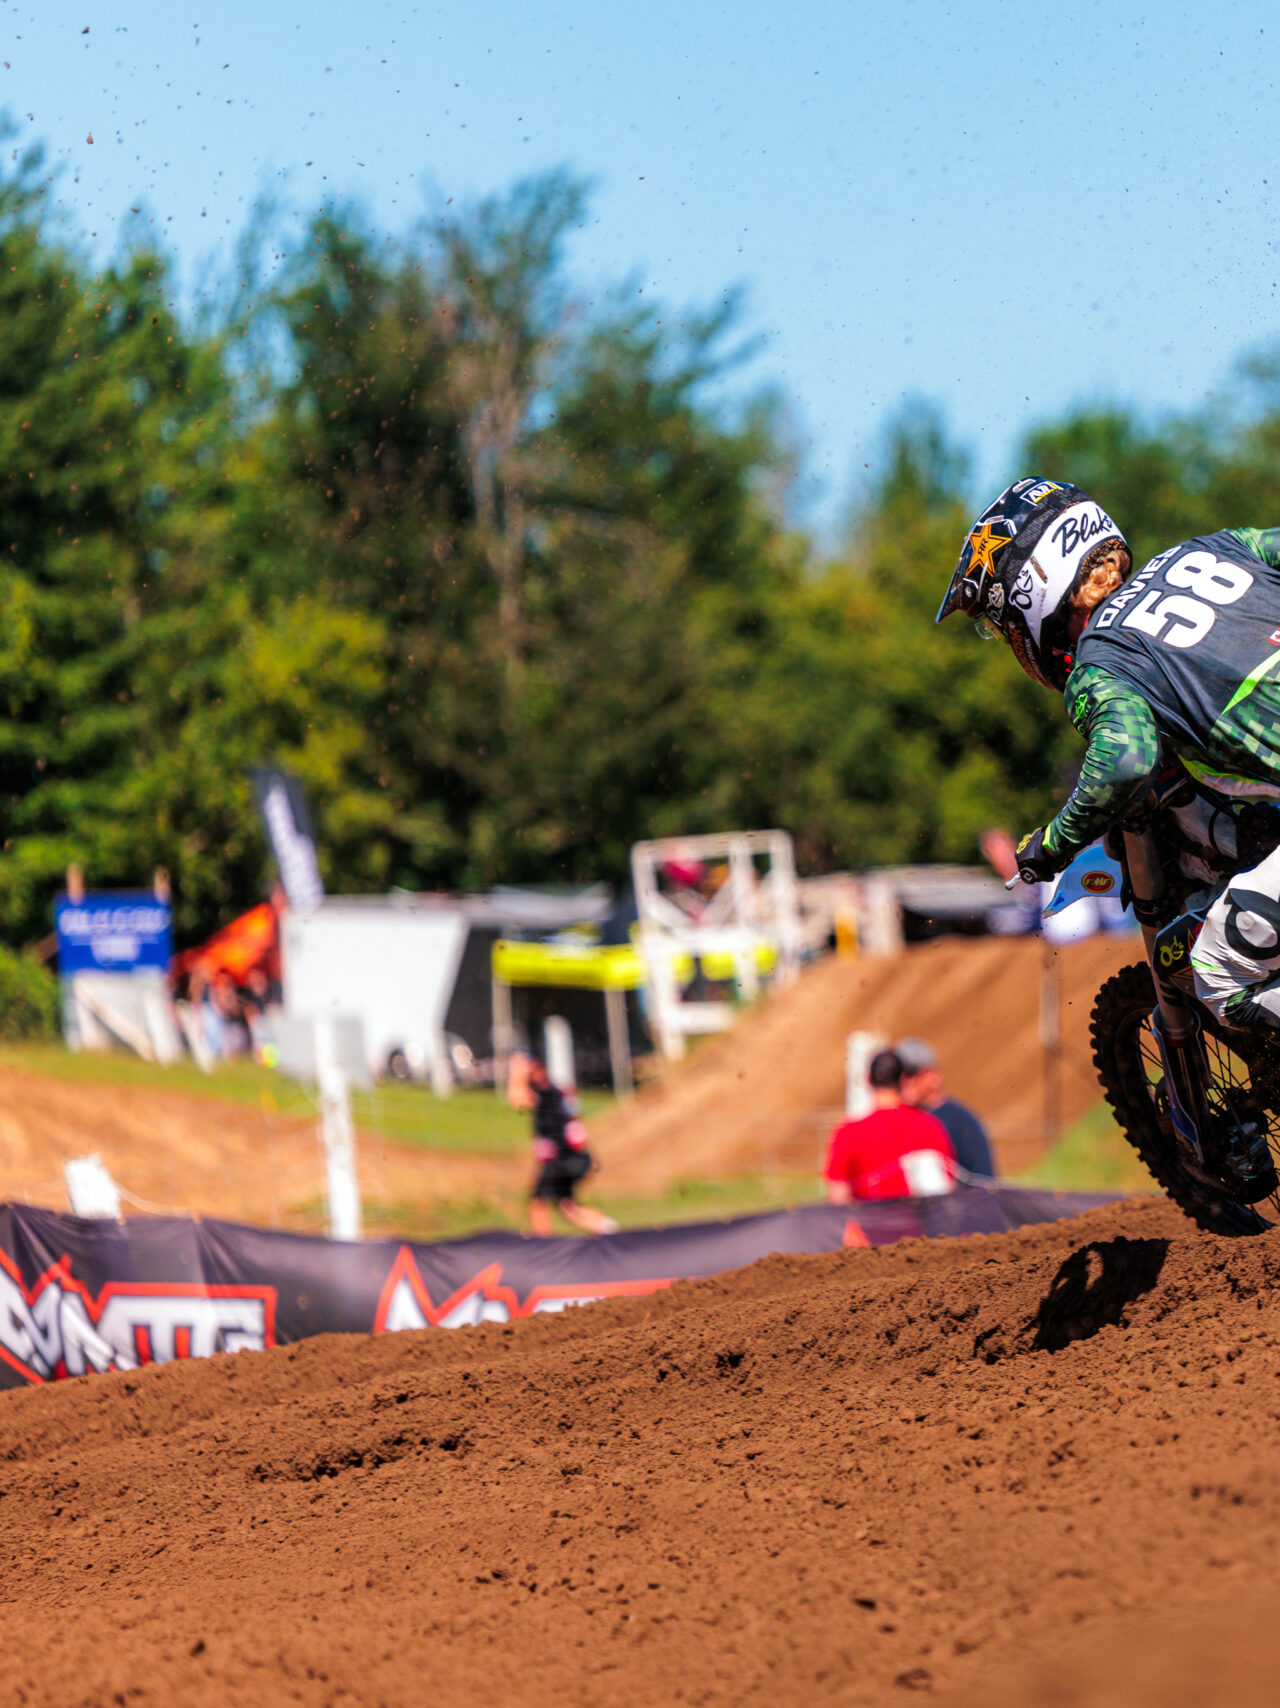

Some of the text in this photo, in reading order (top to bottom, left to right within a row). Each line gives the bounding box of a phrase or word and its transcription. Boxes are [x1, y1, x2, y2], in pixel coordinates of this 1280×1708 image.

[1051, 507, 1113, 558] Blake
[1120, 550, 1255, 649] 58
[1085, 876, 1112, 886] FMF
